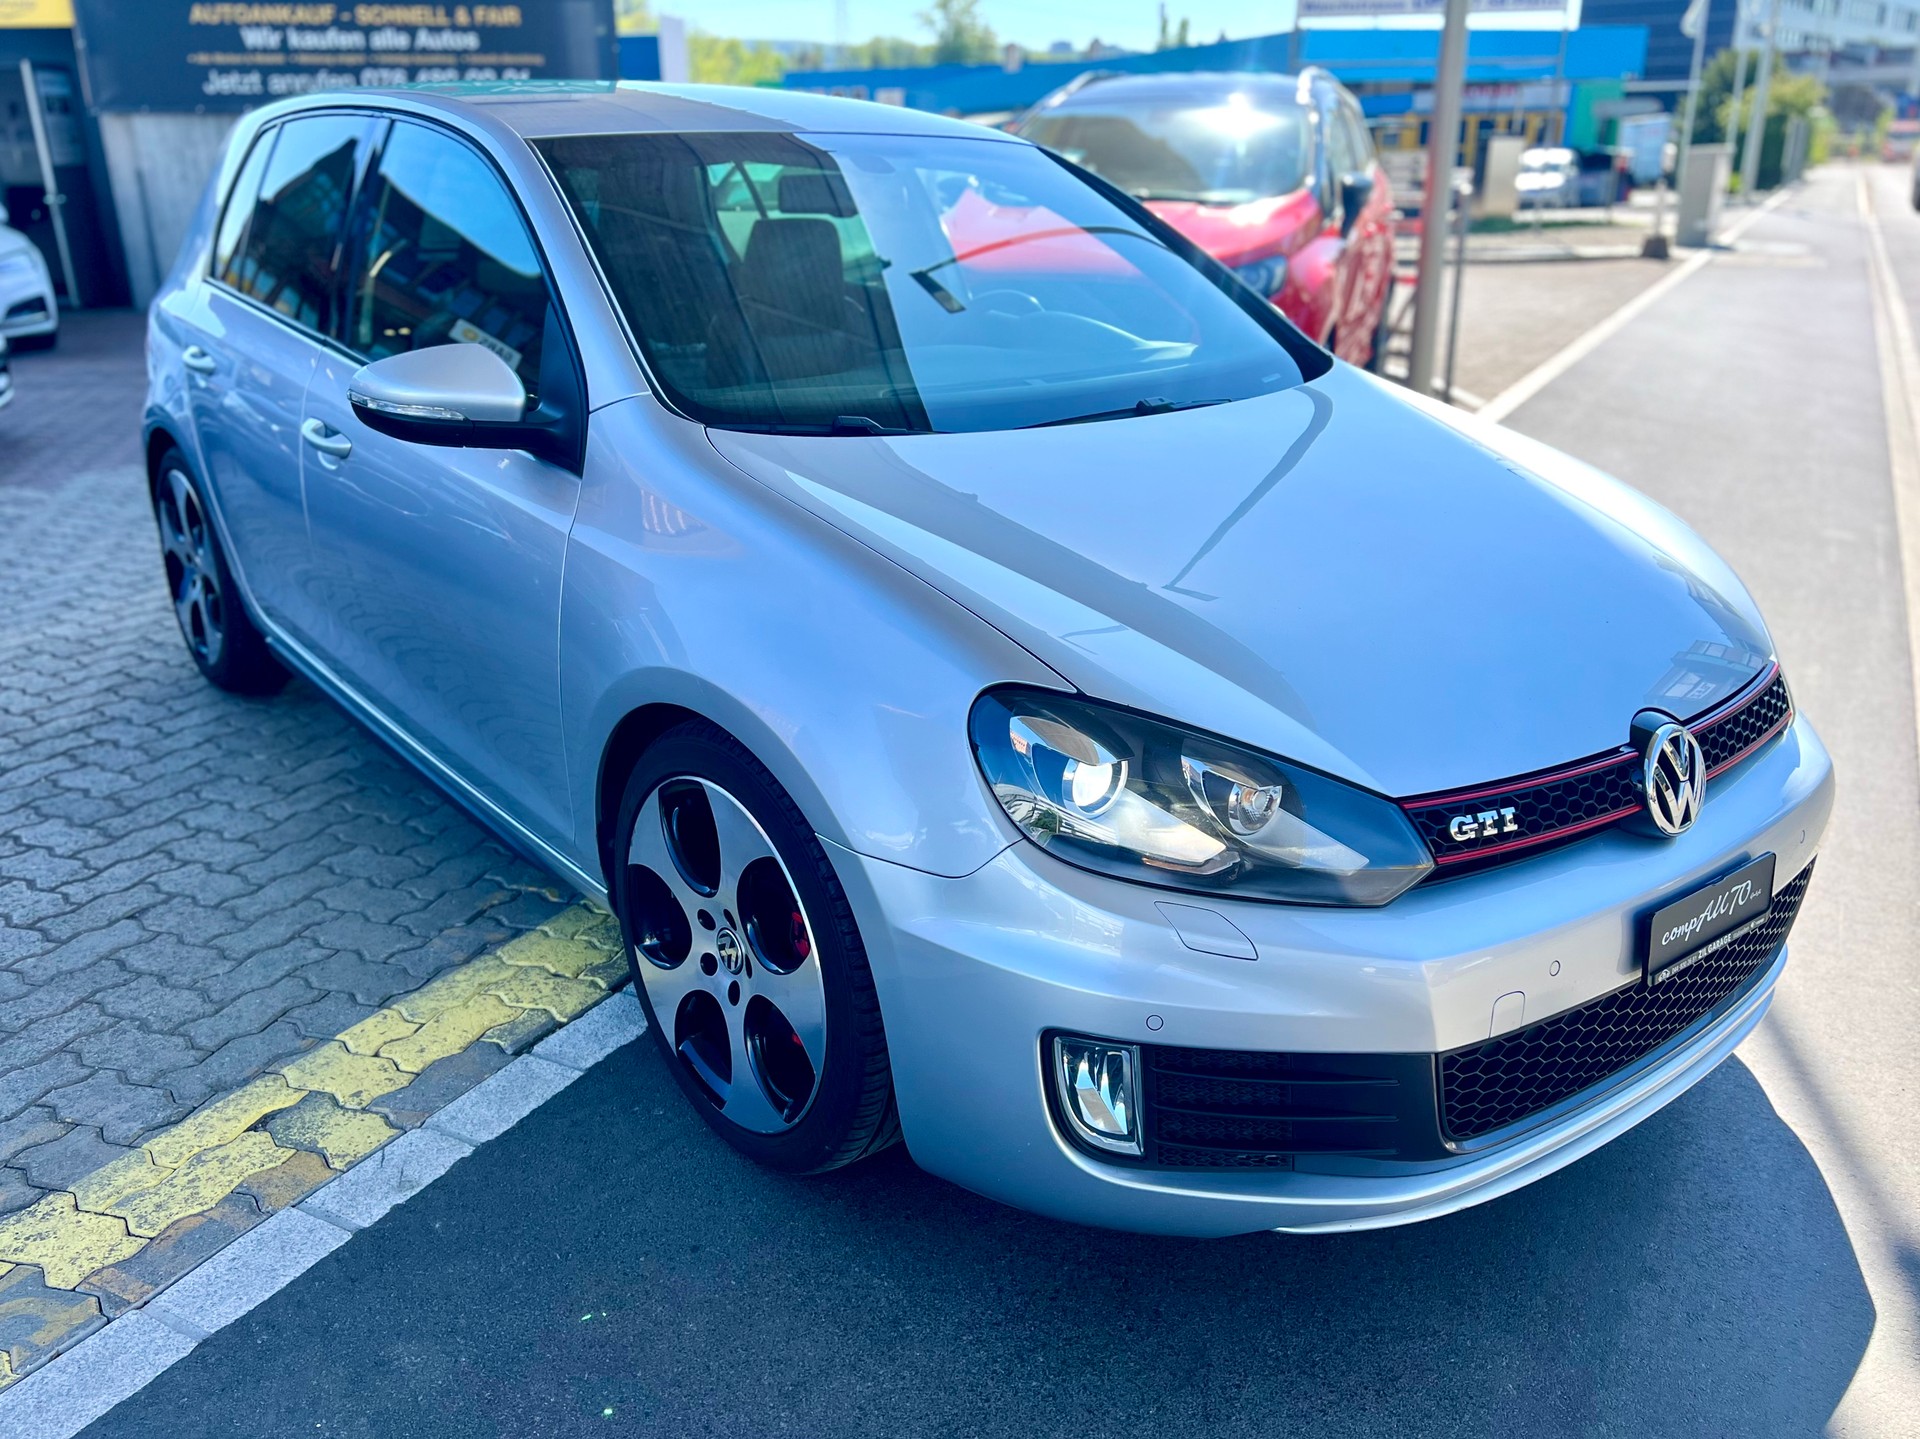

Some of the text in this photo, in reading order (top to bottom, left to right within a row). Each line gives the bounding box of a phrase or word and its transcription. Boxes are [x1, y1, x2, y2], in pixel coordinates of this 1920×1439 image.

[190, 4, 335, 25] AUTOANKAUF
[354, 4, 450, 26] SCHNELL
[454, 5, 471, 26] &
[473, 5, 521, 27] FAIR
[239, 26, 480, 51] Wir kaufen alle Autos
[202, 68, 264, 95] Jetzt
[267, 68, 357, 95] anrufen
[1450, 806, 1518, 841] GTI
[1707, 933, 1732, 953] GARAGE
